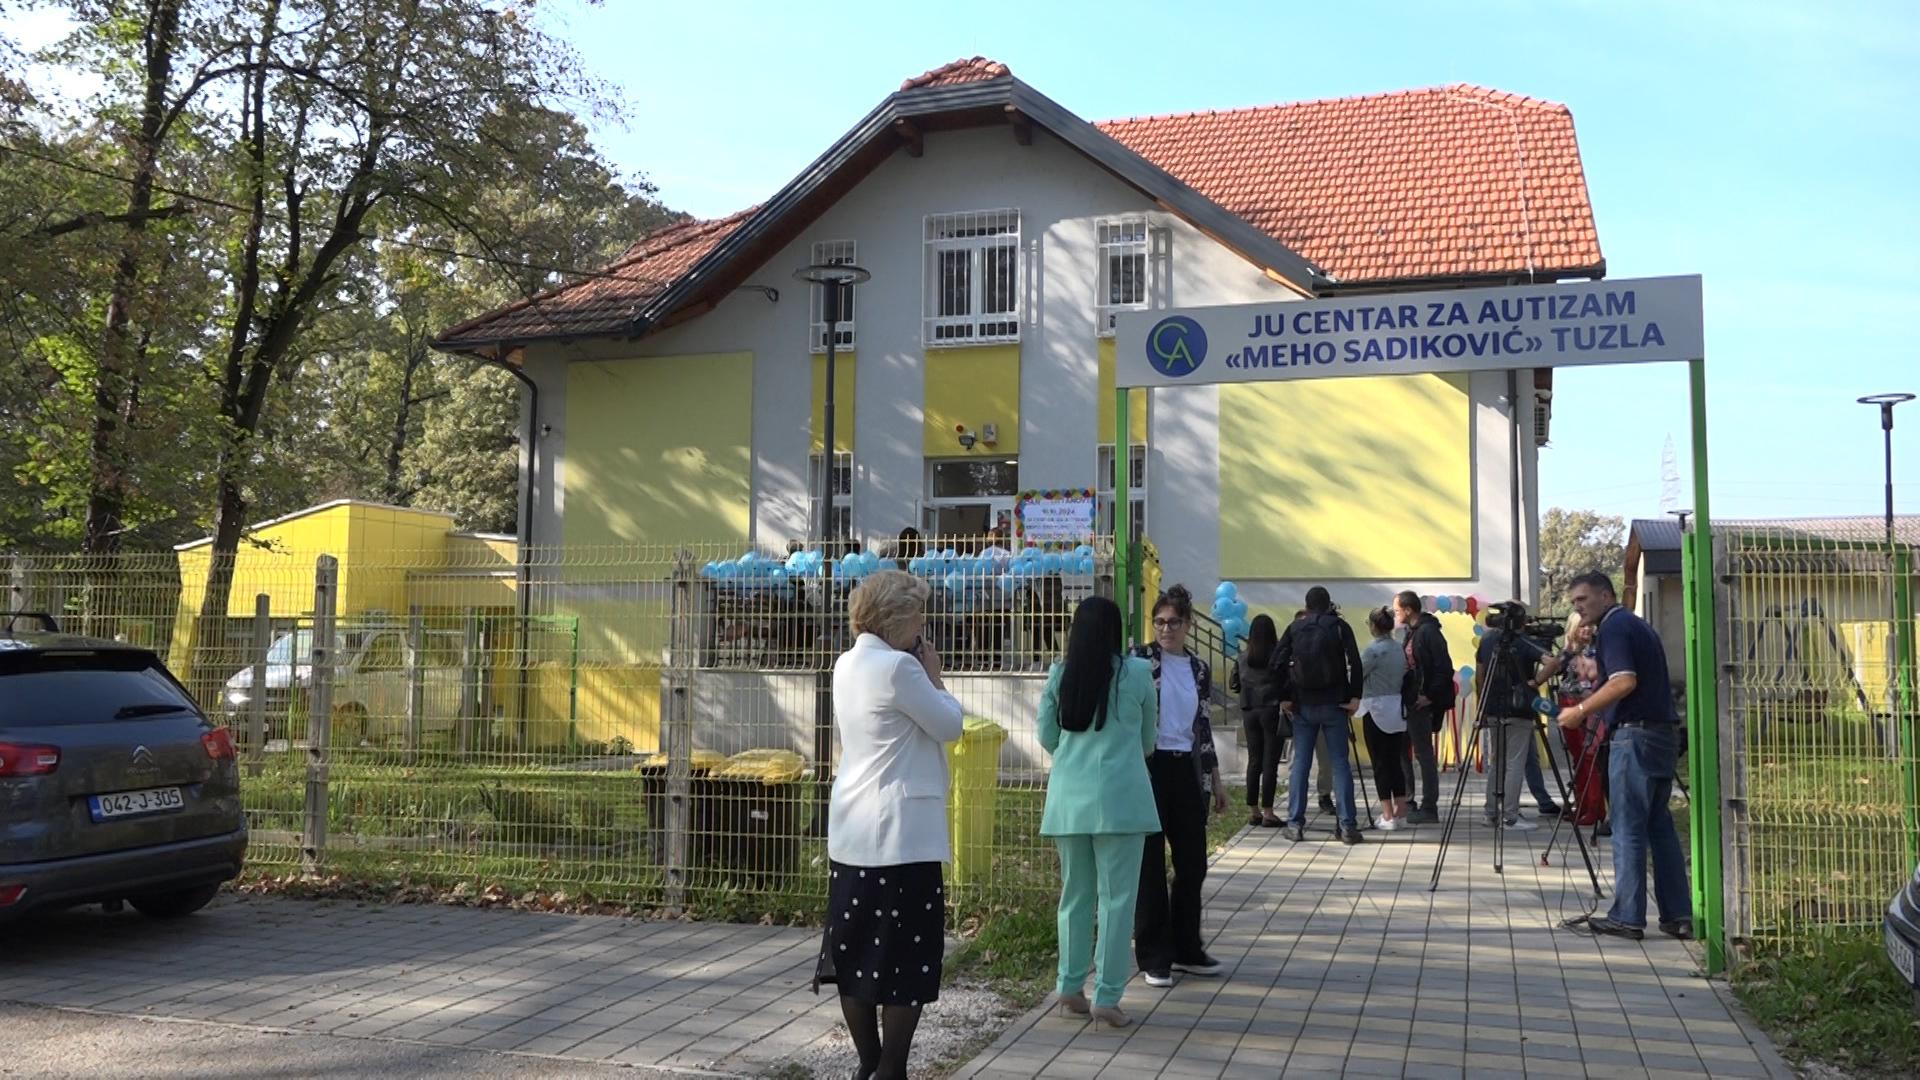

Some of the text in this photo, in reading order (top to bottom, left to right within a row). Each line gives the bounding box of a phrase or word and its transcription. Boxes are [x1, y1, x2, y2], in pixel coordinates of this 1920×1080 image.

[1248, 290, 1636, 338] JU CENTAR ZA AUTIZAM
[1550, 322, 1666, 352] TUZLA
[102, 789, 180, 813] 042-J-305
